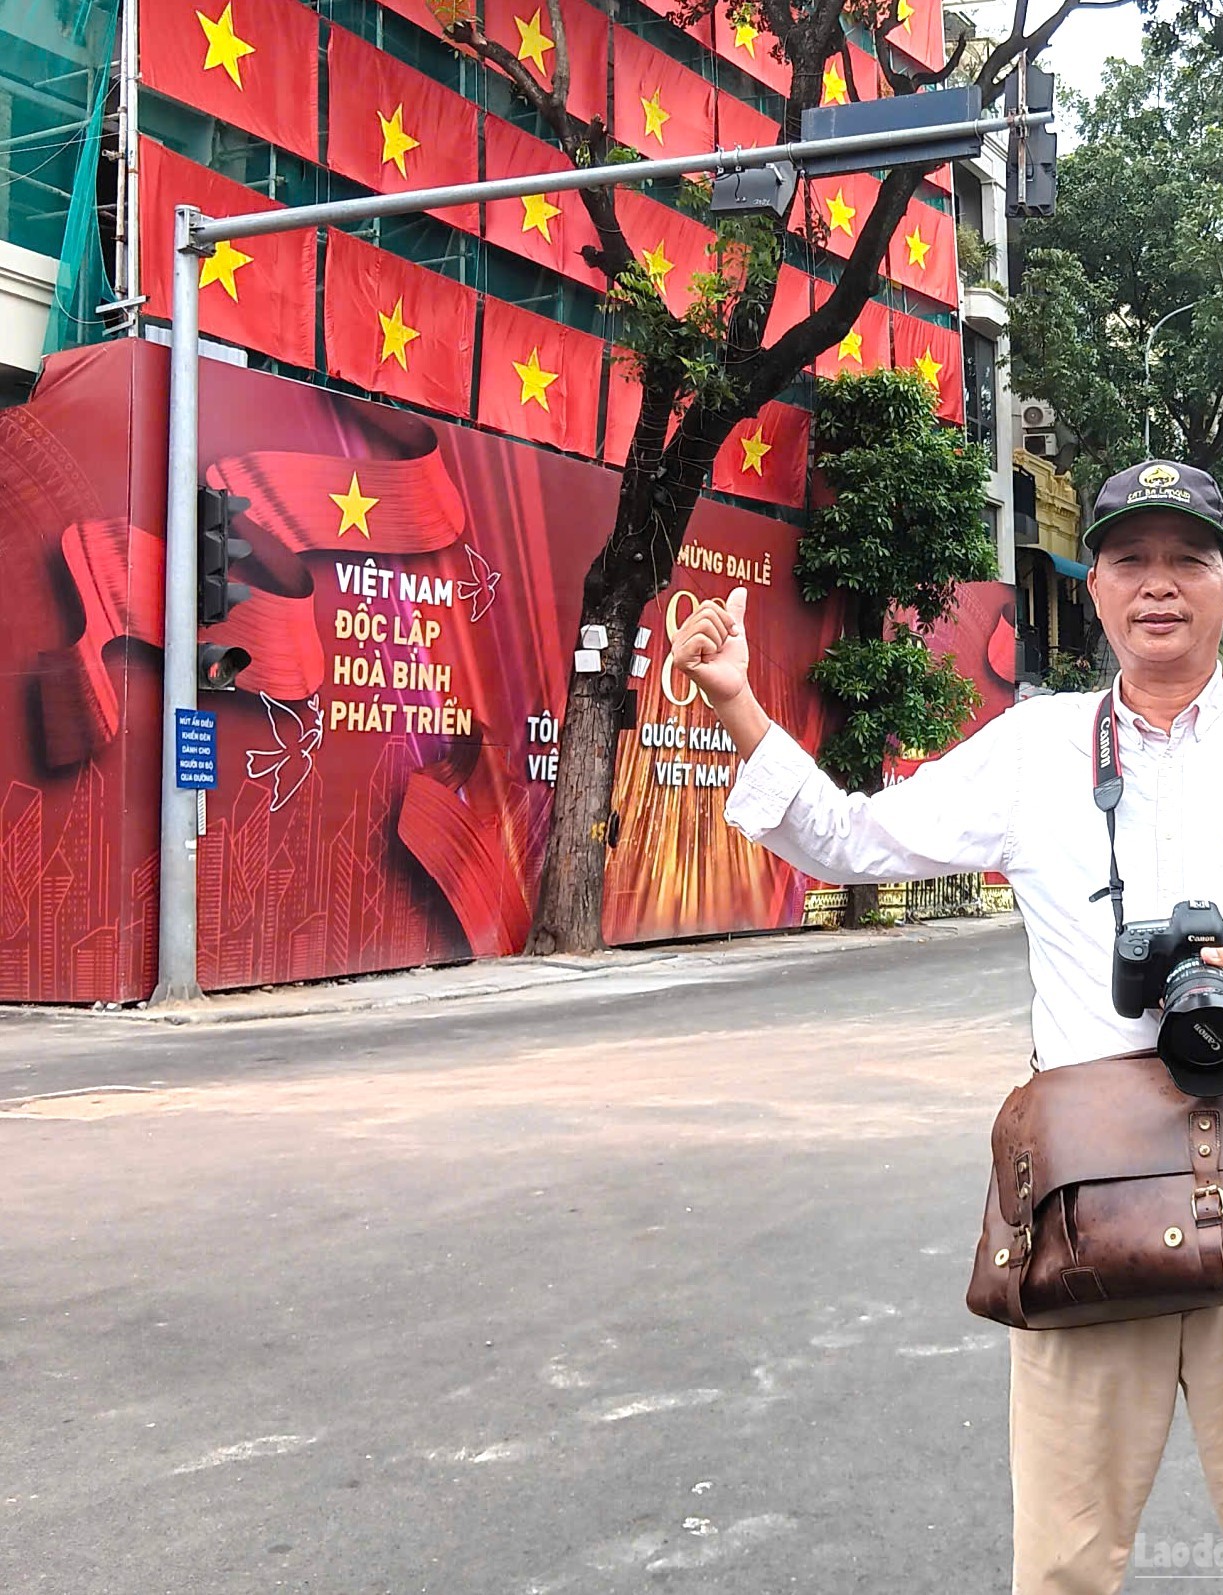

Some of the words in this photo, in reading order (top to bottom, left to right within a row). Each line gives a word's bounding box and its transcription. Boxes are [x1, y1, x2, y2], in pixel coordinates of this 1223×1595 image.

[335, 558, 394, 605] VIỆT
[400, 573, 453, 607] NAM
[677, 540, 723, 574] MỪNG
[727, 555, 750, 585] ĐẠI
[755, 552, 771, 586] LỄ
[335, 603, 388, 649] ĐỘC
[394, 610, 441, 654] LẬP
[333, 650, 387, 688] HOÀ
[393, 653, 451, 693] BÌNH
[330, 694, 397, 733] PHÁT
[403, 697, 472, 736] TRIỂN
[527, 709, 559, 744] TÔI
[641, 716, 686, 749] QUỐC
[1100, 716, 1111, 769] Canon
[528, 749, 559, 788] VIỆ
[656, 755, 693, 790] VIỆT
[695, 764, 730, 787] NAM
[1193, 1023, 1221, 1051] Canon
